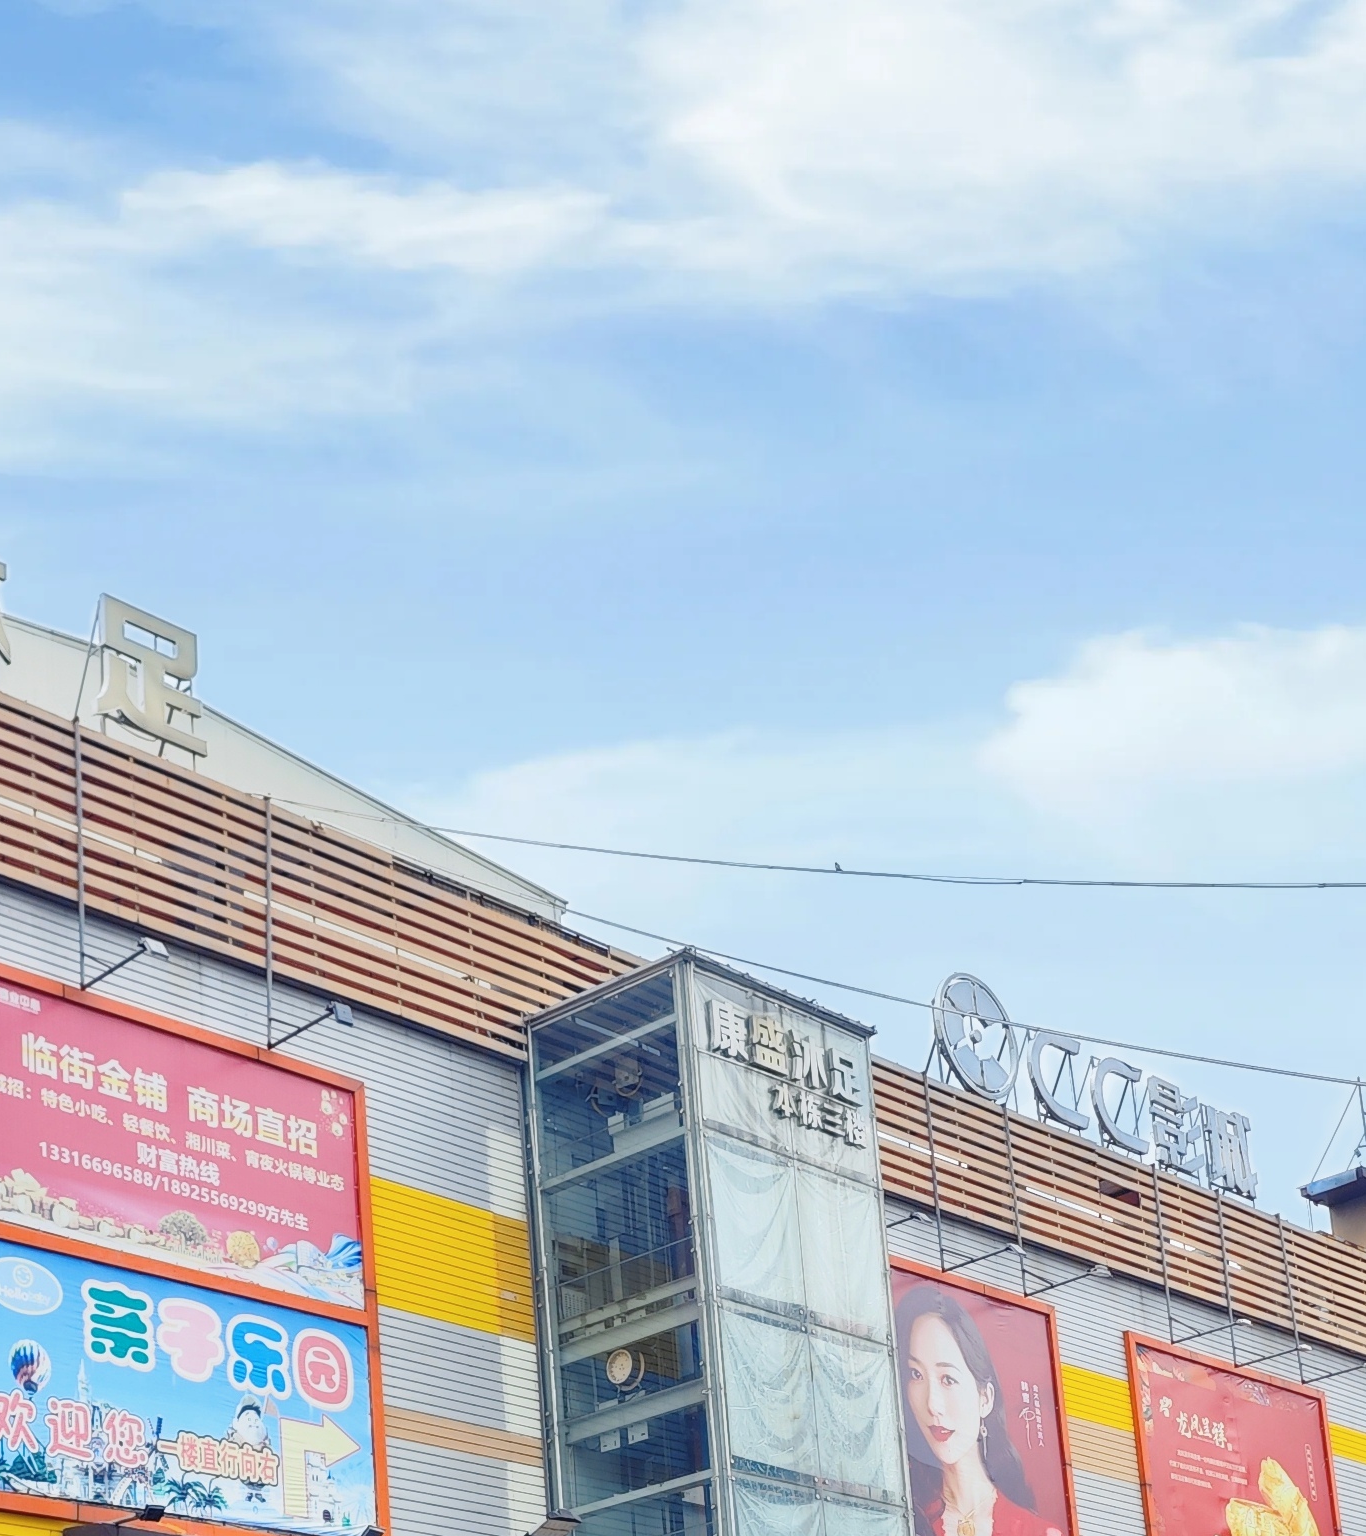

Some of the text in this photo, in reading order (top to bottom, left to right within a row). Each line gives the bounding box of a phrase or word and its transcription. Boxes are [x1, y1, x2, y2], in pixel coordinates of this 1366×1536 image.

[22, 1031, 319, 1159] 临街金铺 商场直招
[709, 1000, 863, 1108] 康盛沐足
[136, 1141, 221, 1187] 财富热线
[83, 1280, 353, 1411] 亲子乐园
[157, 1430, 280, 1487] 一楼直行向右
